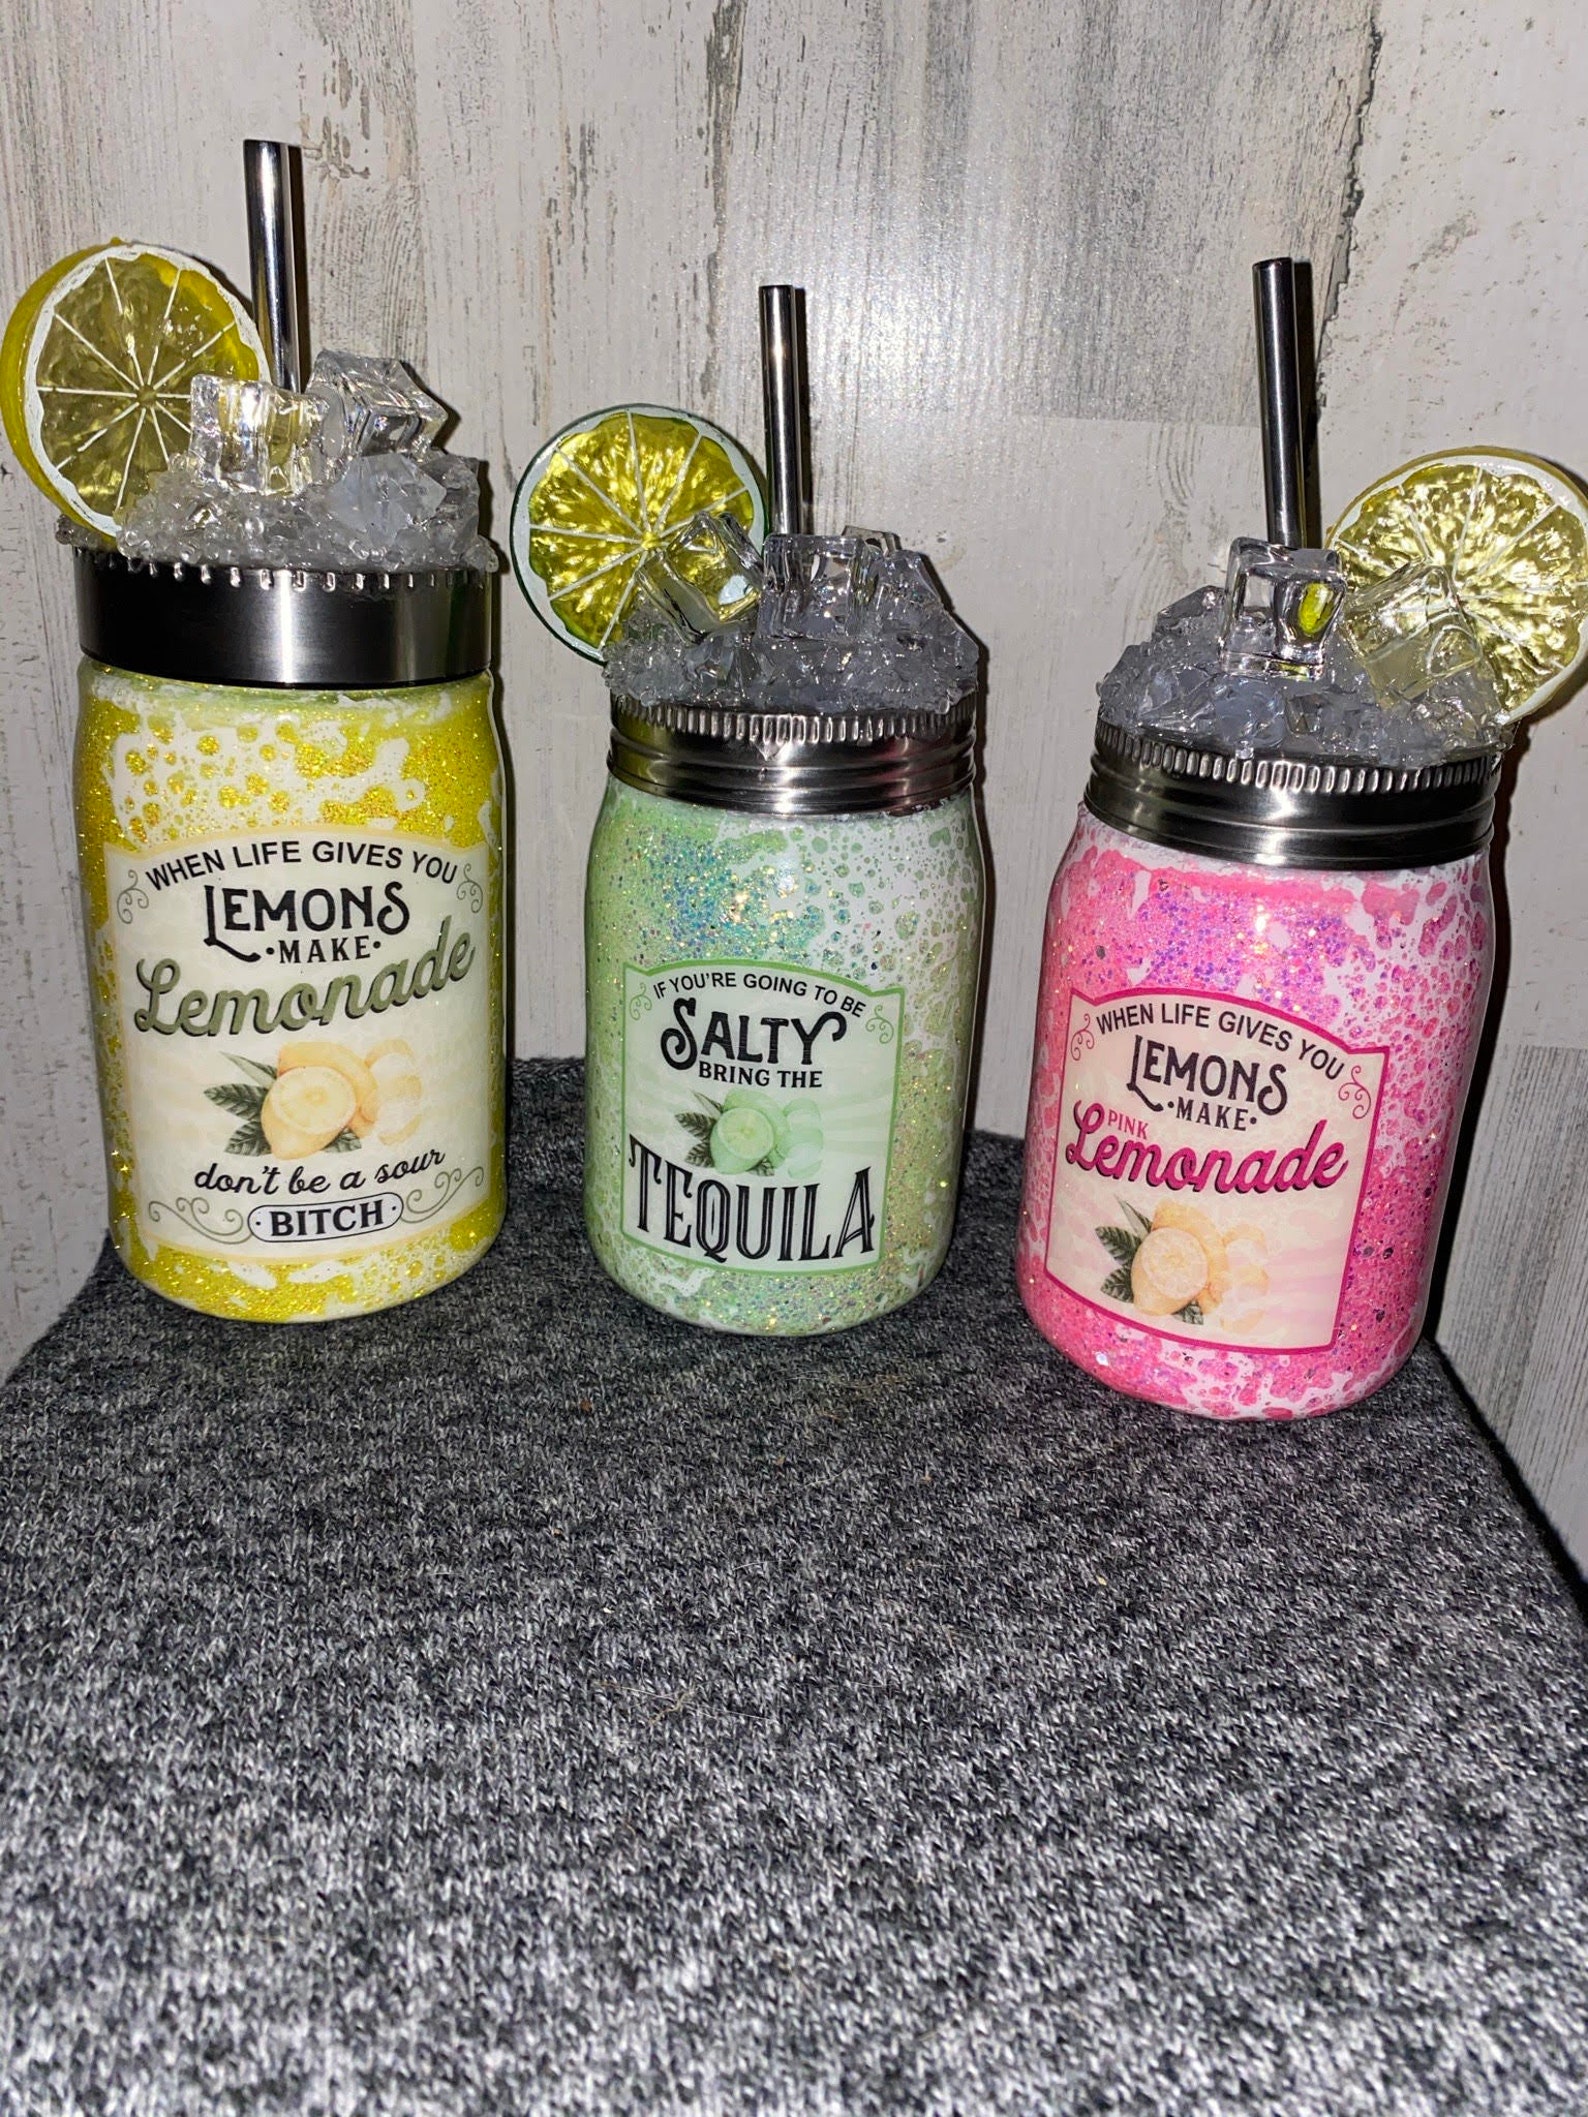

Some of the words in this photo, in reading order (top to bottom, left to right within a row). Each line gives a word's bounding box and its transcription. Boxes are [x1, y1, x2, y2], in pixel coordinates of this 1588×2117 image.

[145, 849, 225, 891] WHEN
[232, 841, 301, 868] LIFE
[312, 840, 402, 868] GIVES
[411, 851, 458, 884] YOU
[202, 881, 410, 962] LEMONS
[134, 914, 476, 1037] Lemonade
[653, 981, 667, 999] IF
[743, 973, 807, 996] GOING
[814, 985, 838, 1005] TO
[840, 996, 866, 1018] BE
[660, 997, 847, 1071] SALTY
[1096, 1003, 1154, 1035] WHEN
[1161, 1004, 1210, 1029] LIFE
[1218, 1011, 1293, 1052] GIVES
[1298, 1039, 1345, 1080] YOU
[699, 1061, 770, 1086] BRING
[777, 1070, 823, 1088] THE
[1127, 1035, 1288, 1116] LEMONS
[1065, 1100, 1348, 1194] Lemonade
[1107, 1109, 1149, 1140] PINK
[288, 1166, 331, 1194] be
[339, 1169, 366, 1191] a
[374, 1147, 446, 1182] sour
[628, 1133, 875, 1263] TEQUILA
[270, 1199, 384, 1238] BITCH
